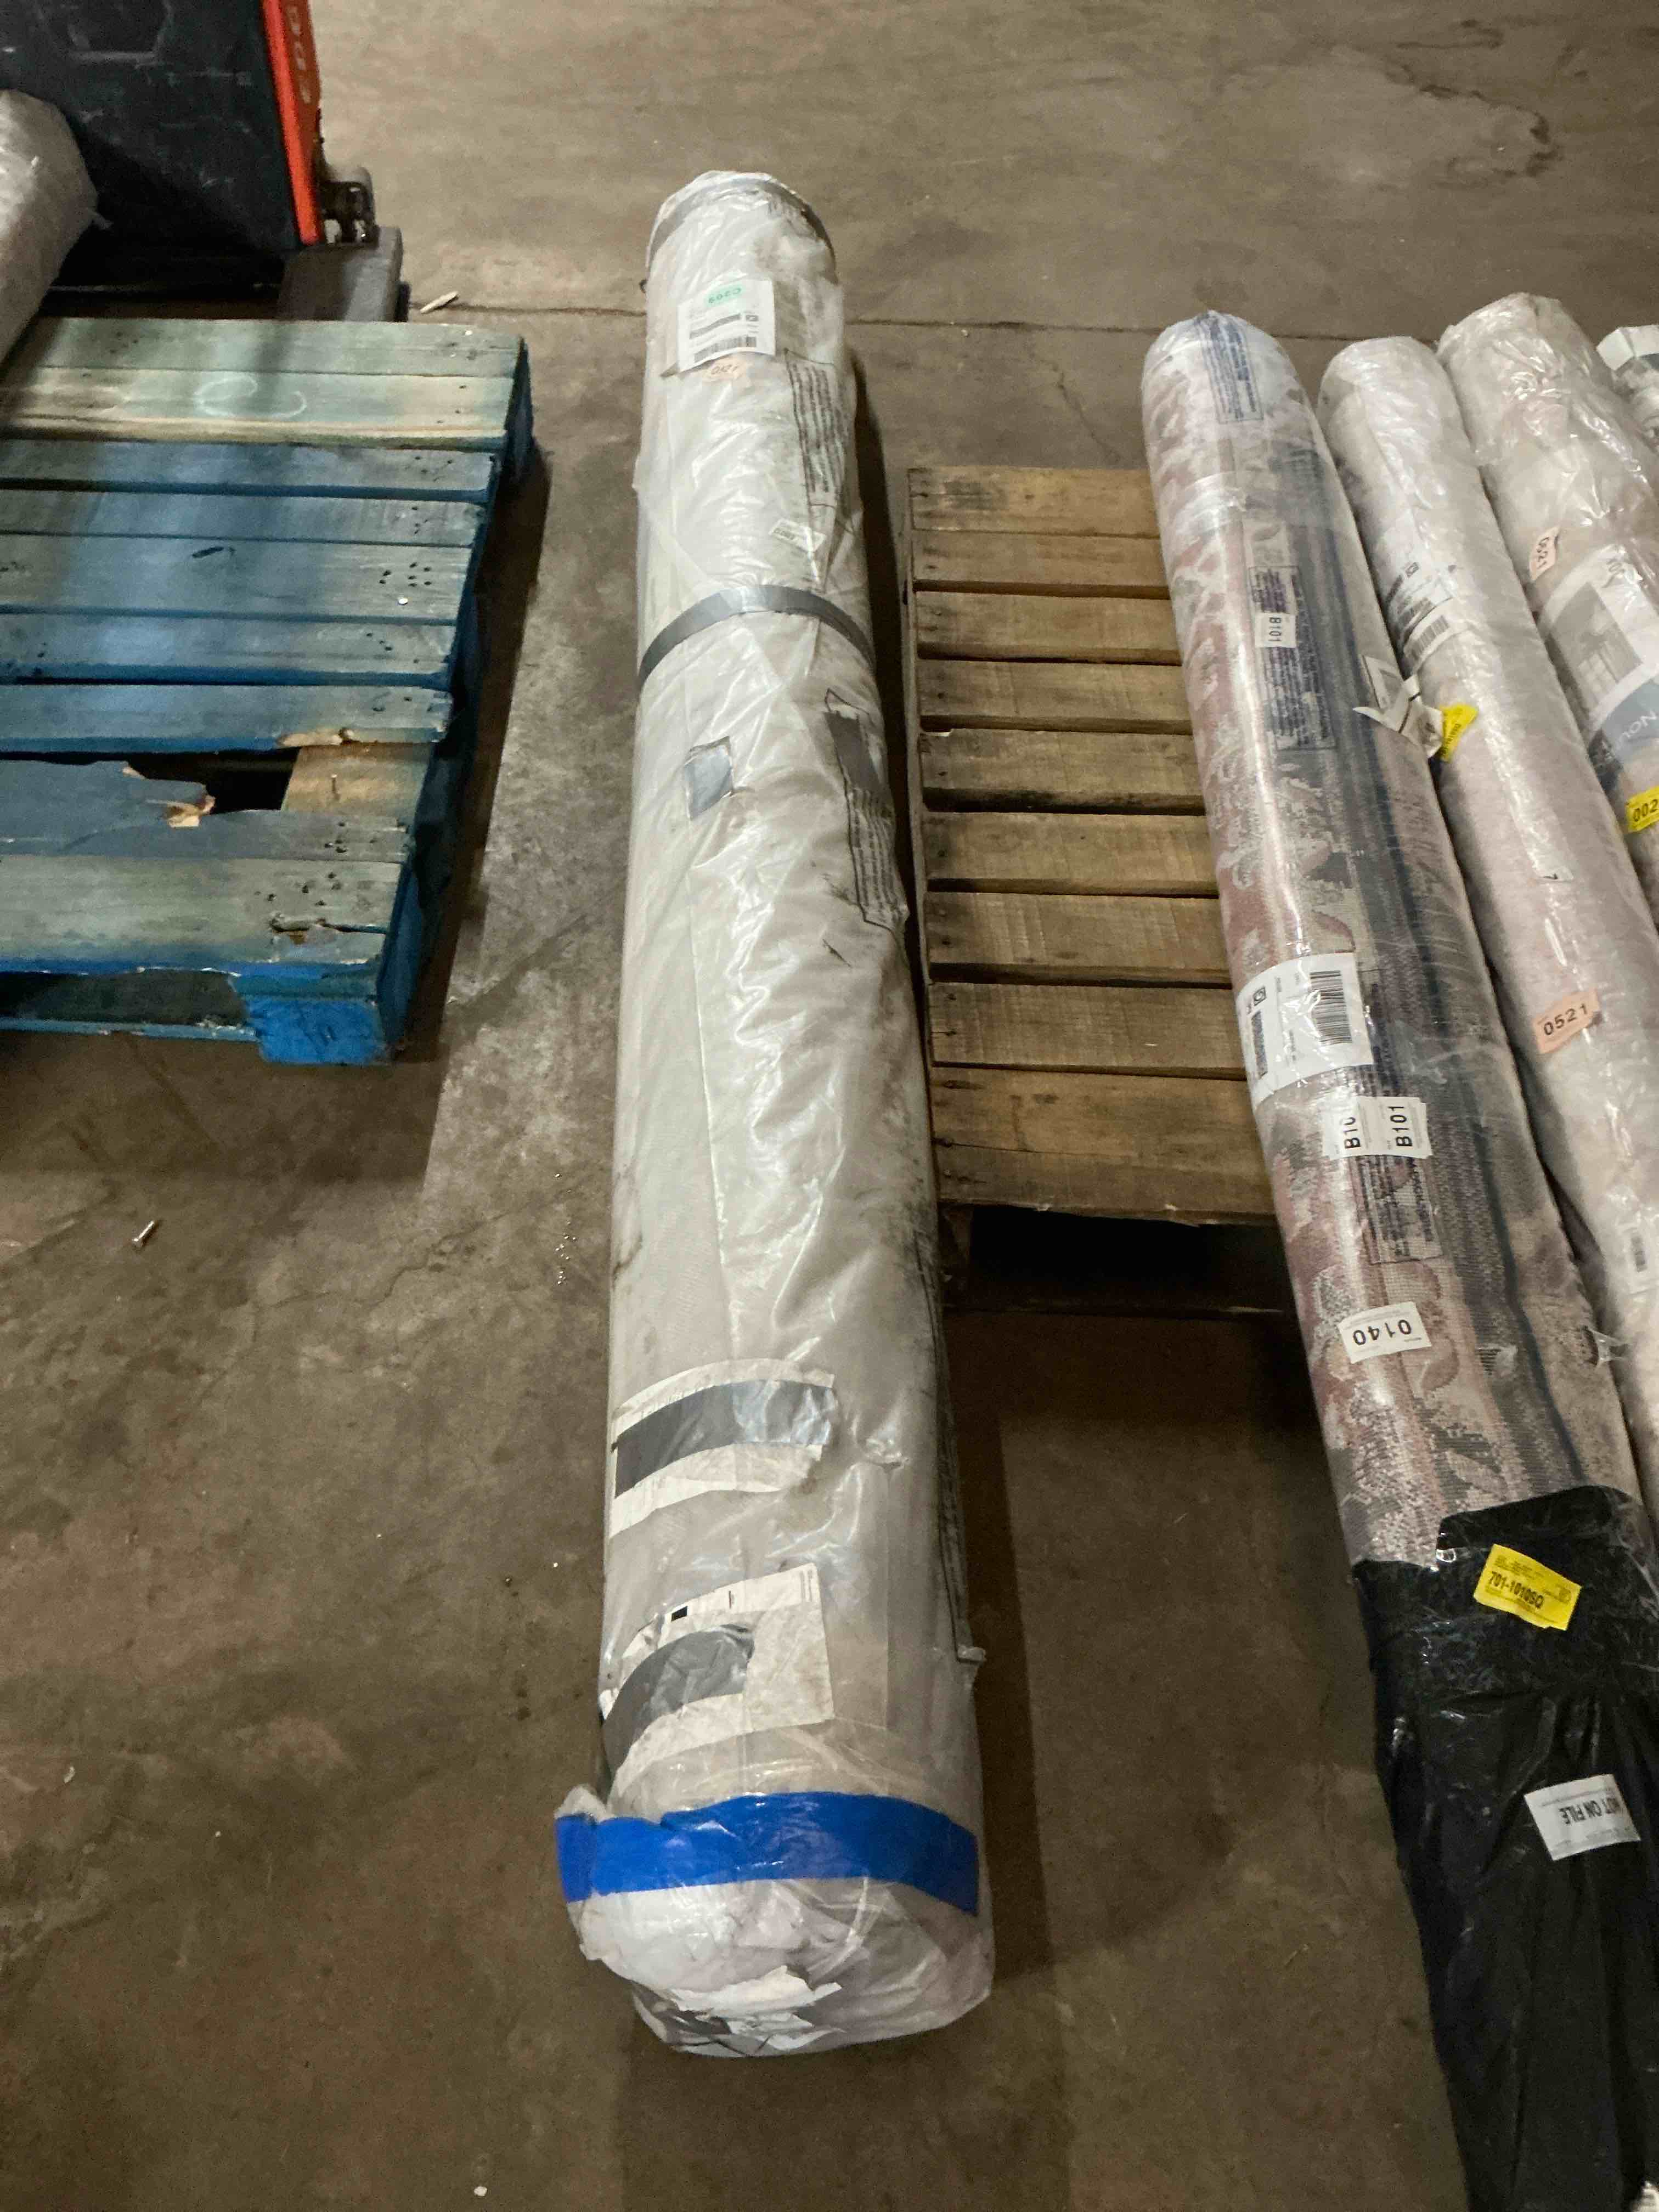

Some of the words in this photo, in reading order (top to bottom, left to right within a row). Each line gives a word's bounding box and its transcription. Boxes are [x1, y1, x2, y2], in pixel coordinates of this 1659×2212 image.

[1268, 617, 1282, 642] B101
[1543, 1003, 1588, 1036] 0521
[1387, 1105, 1413, 1147] B101
[1352, 1319, 1412, 1346] 0140
[1559, 1803, 1586, 1826] FILE
[1583, 1799, 1602, 1818] ON
